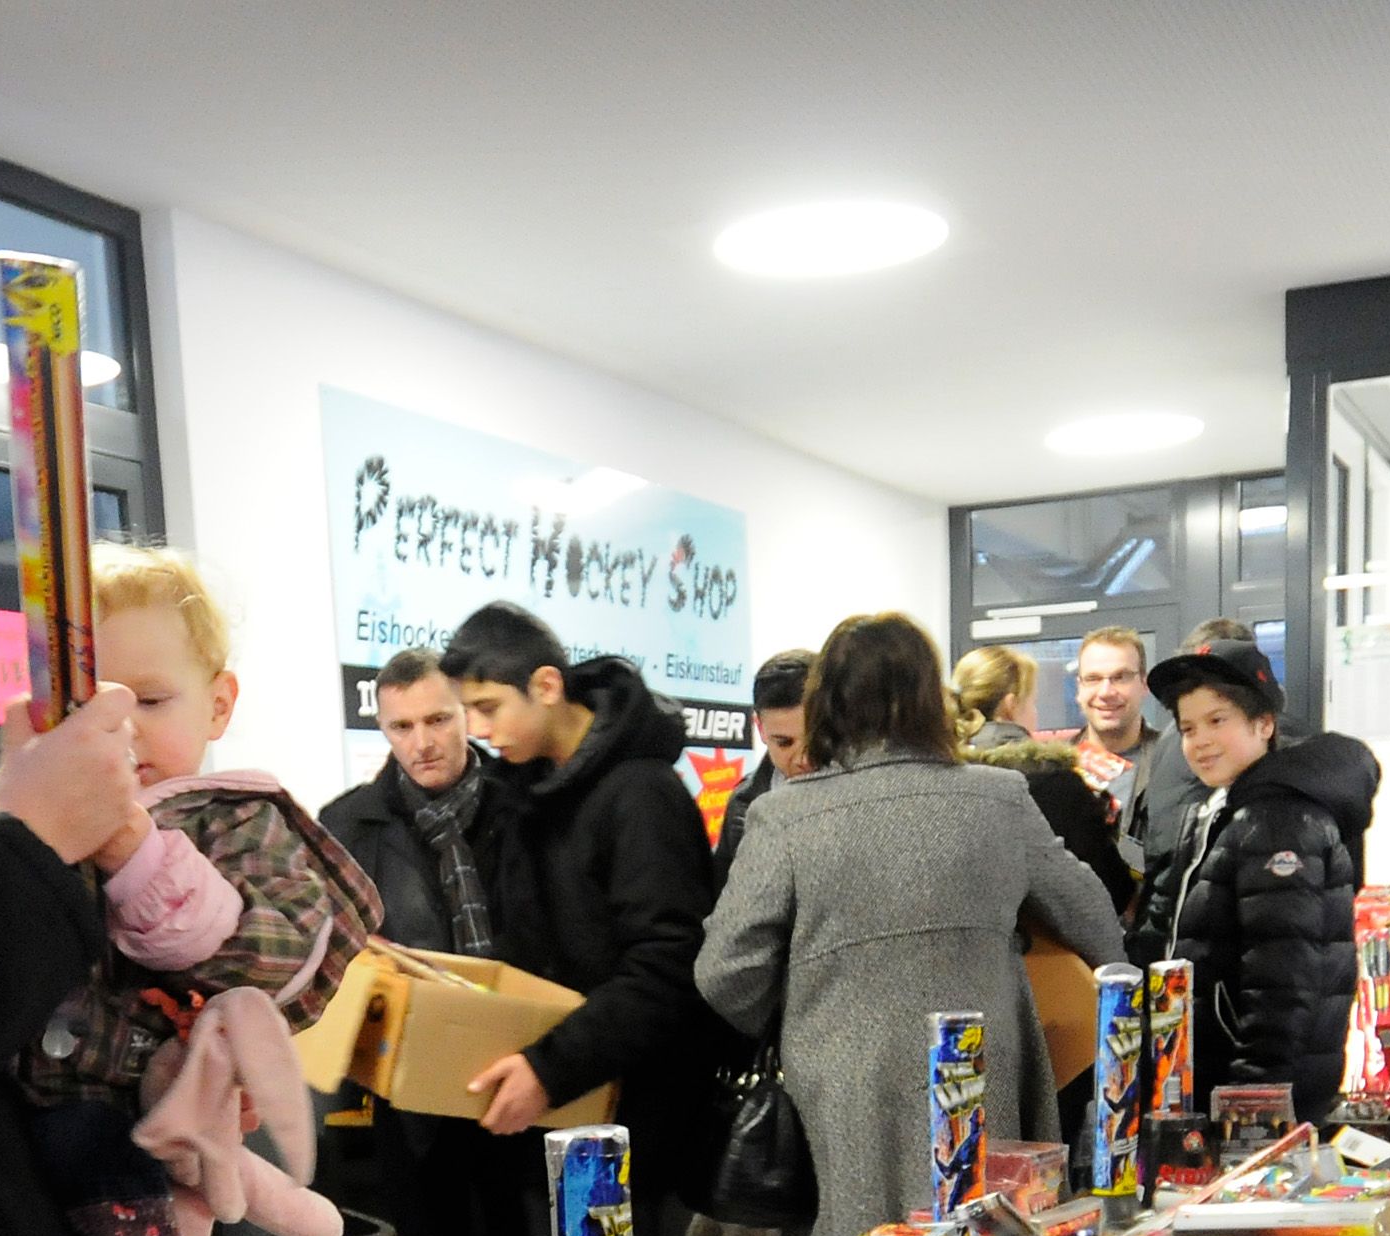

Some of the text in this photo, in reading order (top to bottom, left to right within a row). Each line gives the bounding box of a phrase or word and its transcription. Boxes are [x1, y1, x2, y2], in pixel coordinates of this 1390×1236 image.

[353, 454, 739, 622] Perfect Hockey Shop
[356, 608, 743, 687] Eishocke Eiskunstlauf
[683, 706, 747, 742] AUER
